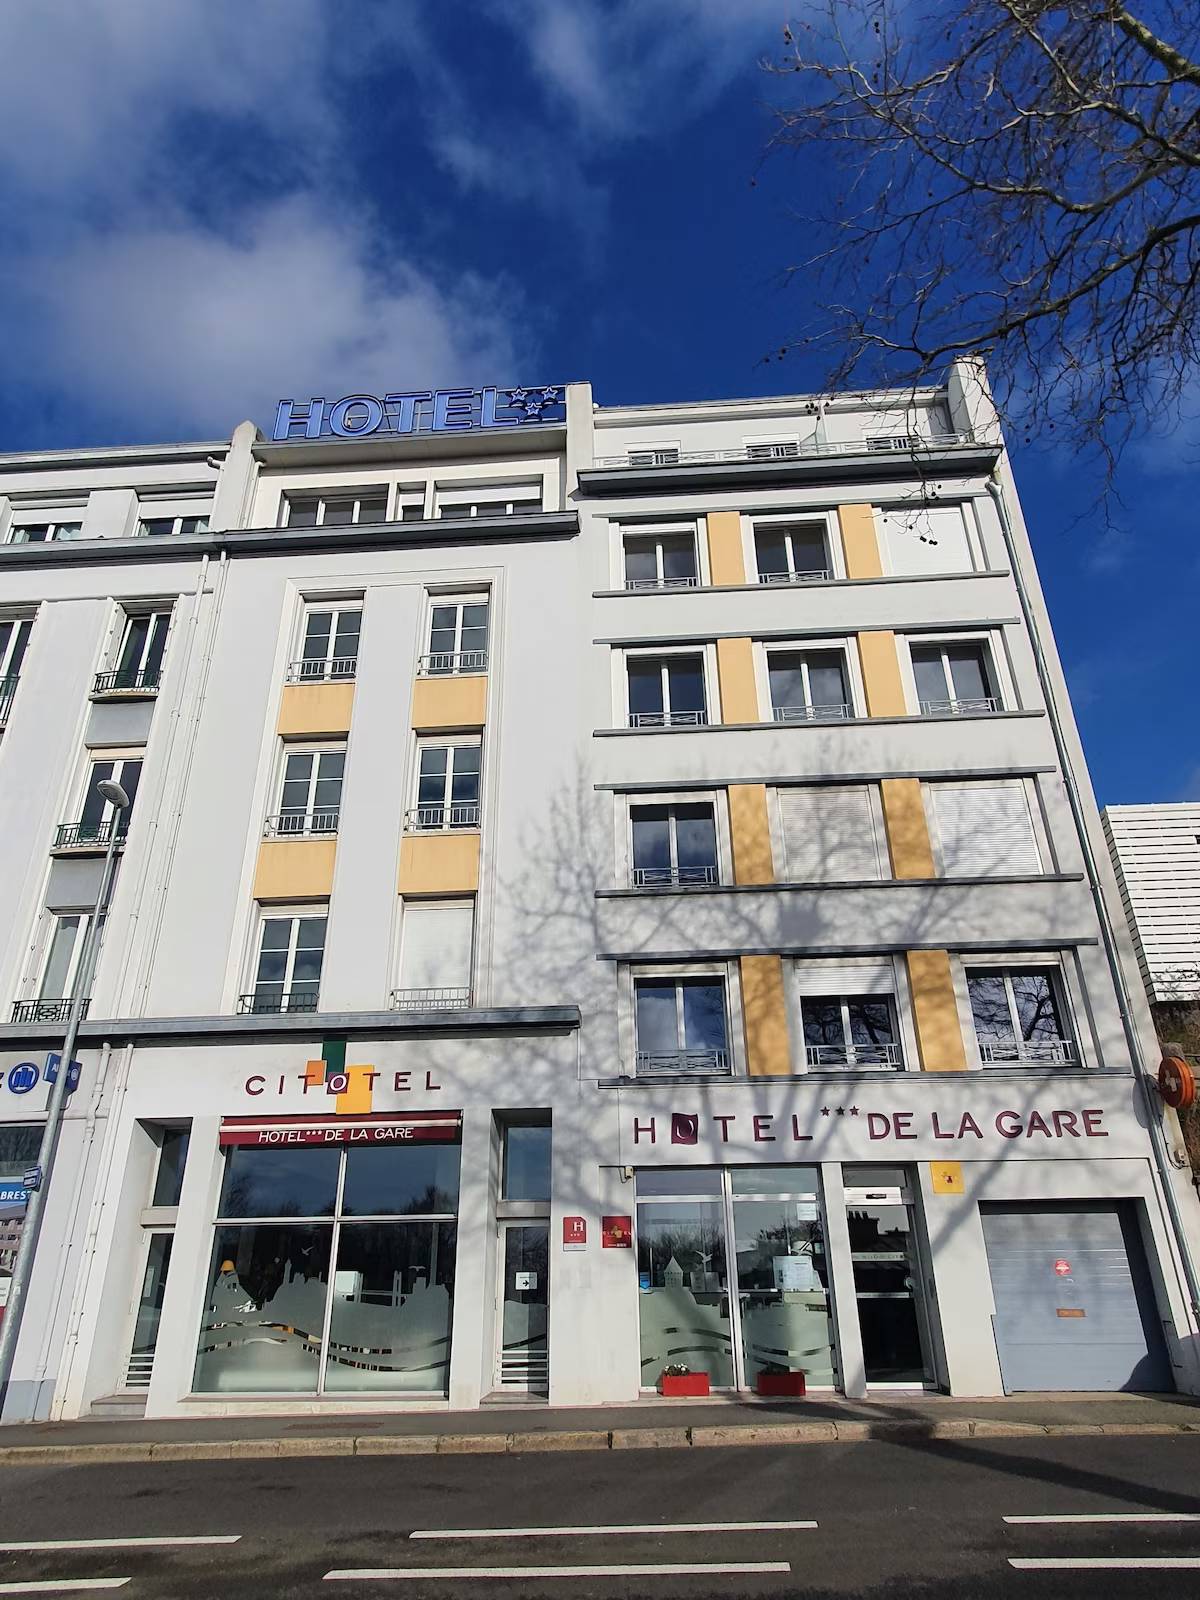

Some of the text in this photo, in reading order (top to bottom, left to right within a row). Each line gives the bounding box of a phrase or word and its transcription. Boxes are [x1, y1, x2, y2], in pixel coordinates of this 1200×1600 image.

[273, 387, 519, 441] HOTEL
[245, 1070, 442, 1096] CITOTEL
[324, 1129, 345, 1142] DE
[350, 1128, 370, 1140] LA
[374, 1127, 415, 1140] GARE
[633, 1109, 1110, 1146] HOTEL DE LA GARE
[573, 1221, 584, 1232] H
